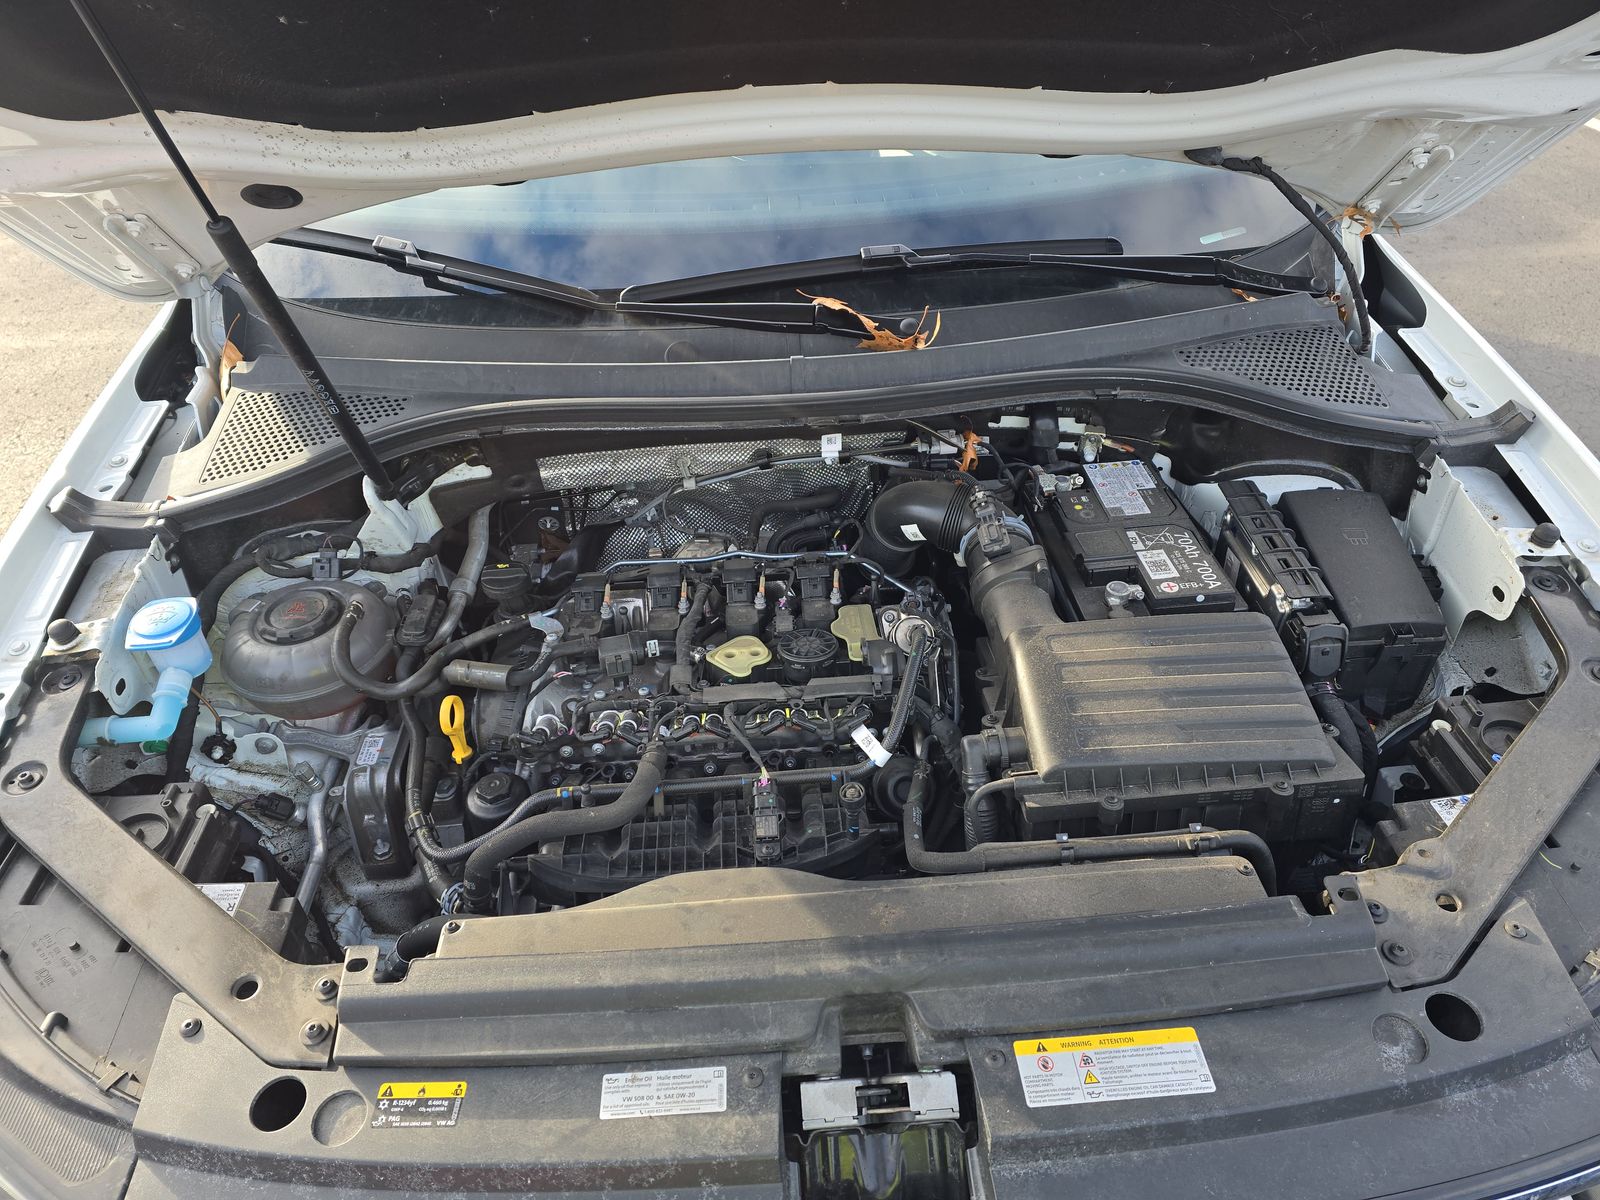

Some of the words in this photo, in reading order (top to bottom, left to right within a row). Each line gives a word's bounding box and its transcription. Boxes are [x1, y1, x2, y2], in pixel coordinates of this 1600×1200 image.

[1174, 532, 1200, 558] 70Ah
[1193, 560, 1222, 589] 700A
[1179, 581, 1204, 590] EFB+
[1060, 1040, 1092, 1048] WARNING
[1099, 1037, 1135, 1045] ATTENTION
[393, 1099, 416, 1107] R-1234yf
